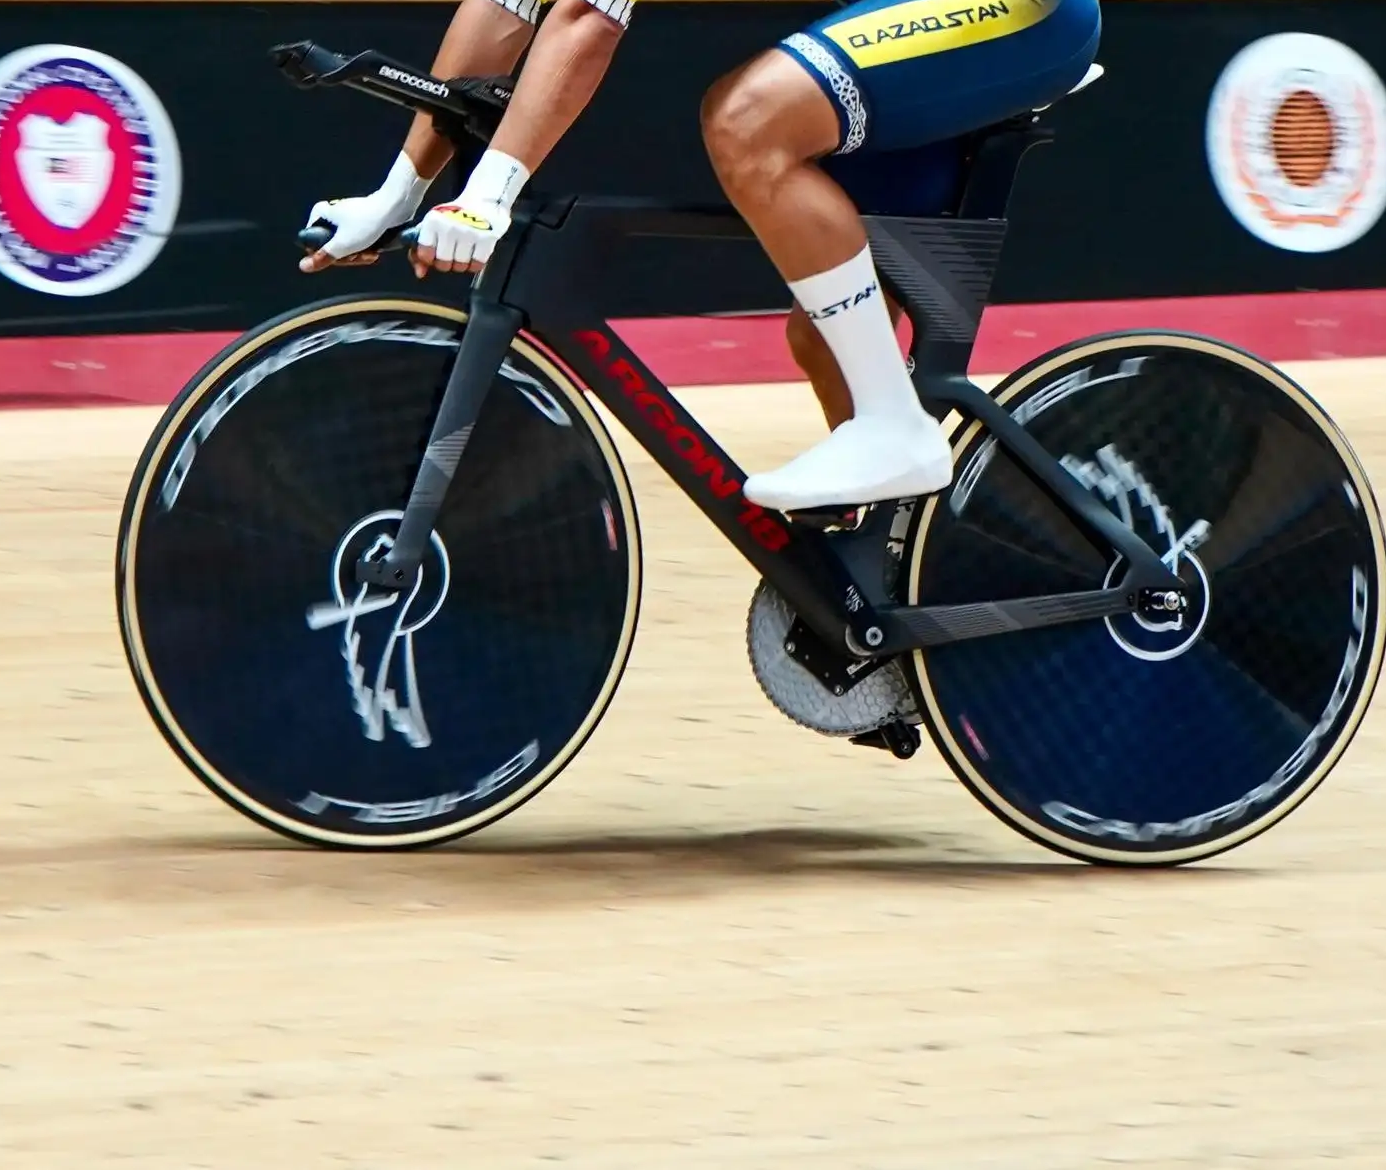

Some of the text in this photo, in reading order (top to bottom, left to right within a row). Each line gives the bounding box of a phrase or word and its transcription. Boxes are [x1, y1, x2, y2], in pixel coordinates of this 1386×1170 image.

[847, 0, 1010, 50] QAZAQSTAN
[378, 64, 450, 99] aerocoach
[572, 328, 742, 501] ARGON
